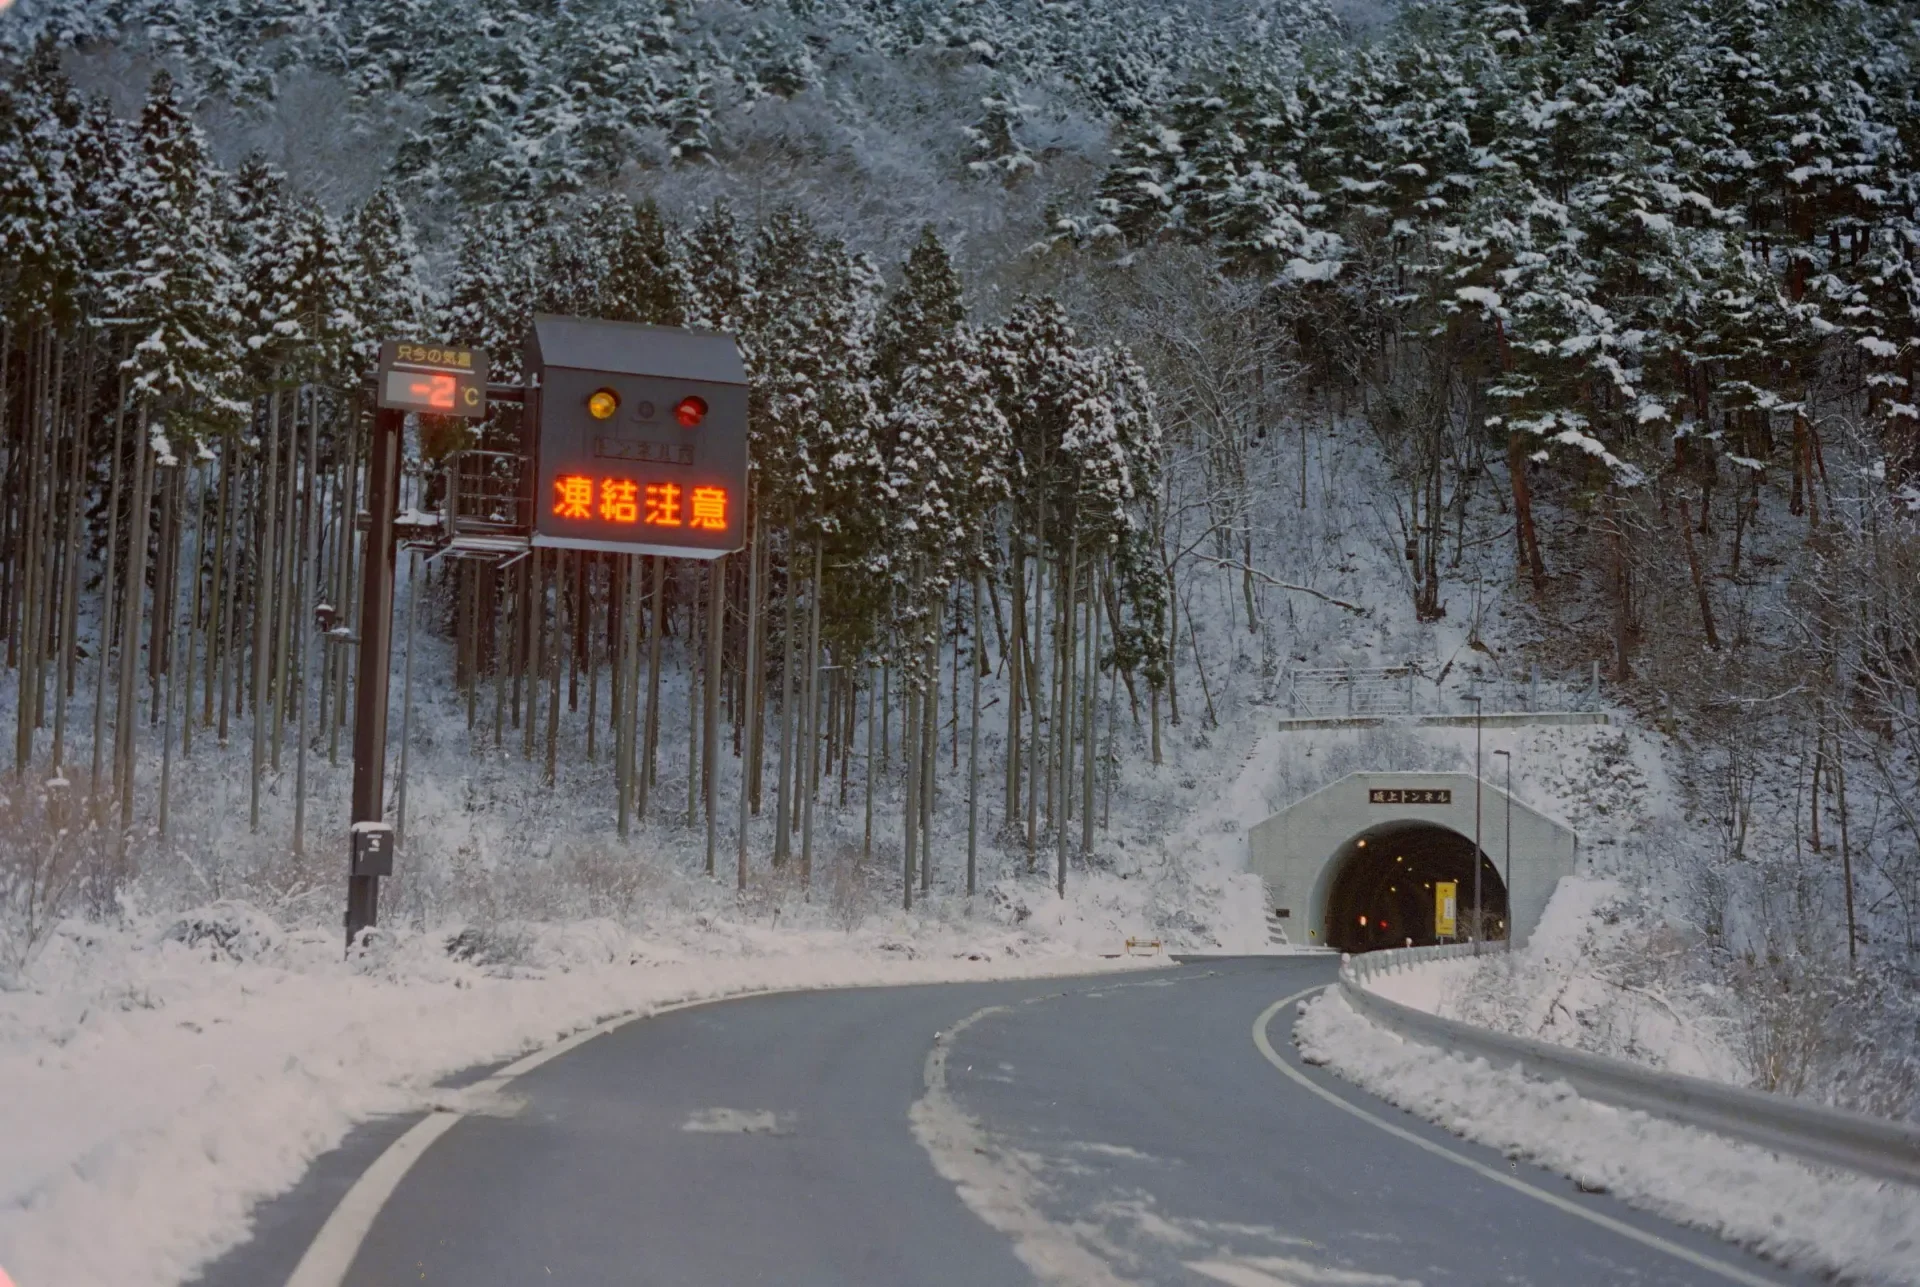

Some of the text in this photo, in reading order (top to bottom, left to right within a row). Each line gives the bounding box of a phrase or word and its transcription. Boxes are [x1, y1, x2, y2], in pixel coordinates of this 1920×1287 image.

[410, 374, 457, 408] -2
[553, 475, 728, 530] 凍結注意
